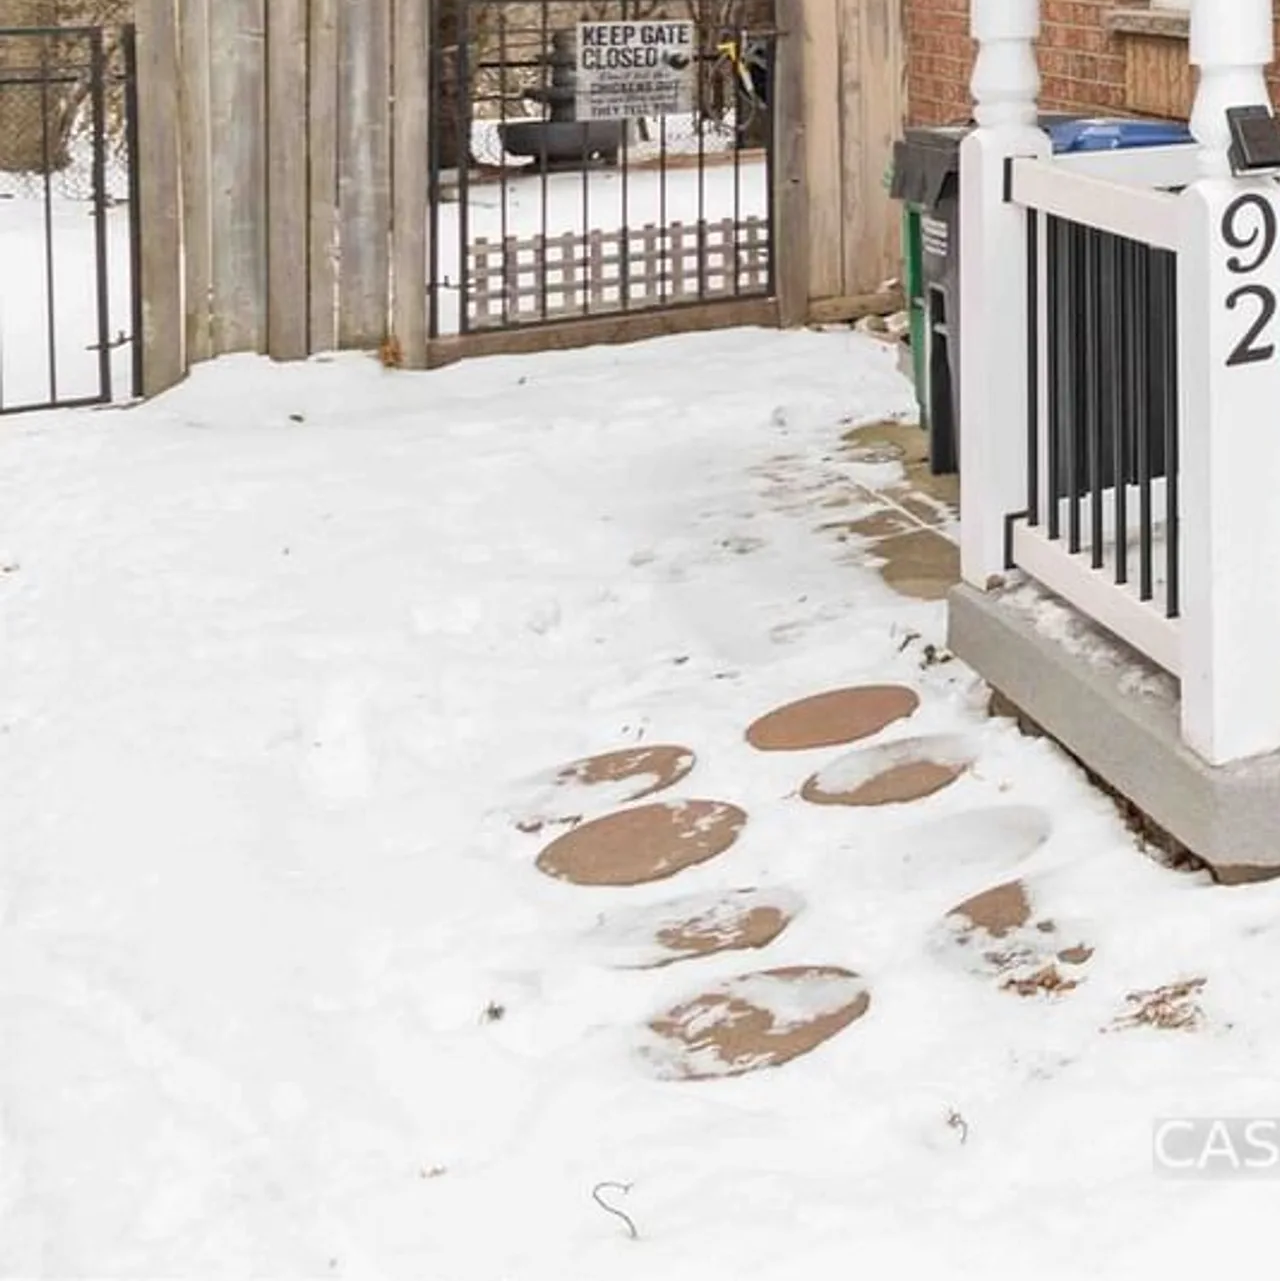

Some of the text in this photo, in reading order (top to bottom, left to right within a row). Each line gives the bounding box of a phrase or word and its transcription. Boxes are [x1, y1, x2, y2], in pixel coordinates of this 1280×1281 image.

[582, 24, 690, 46] KEEP GATE
[582, 46, 658, 70] CLOSED
[1221, 193, 1278, 368] 92
